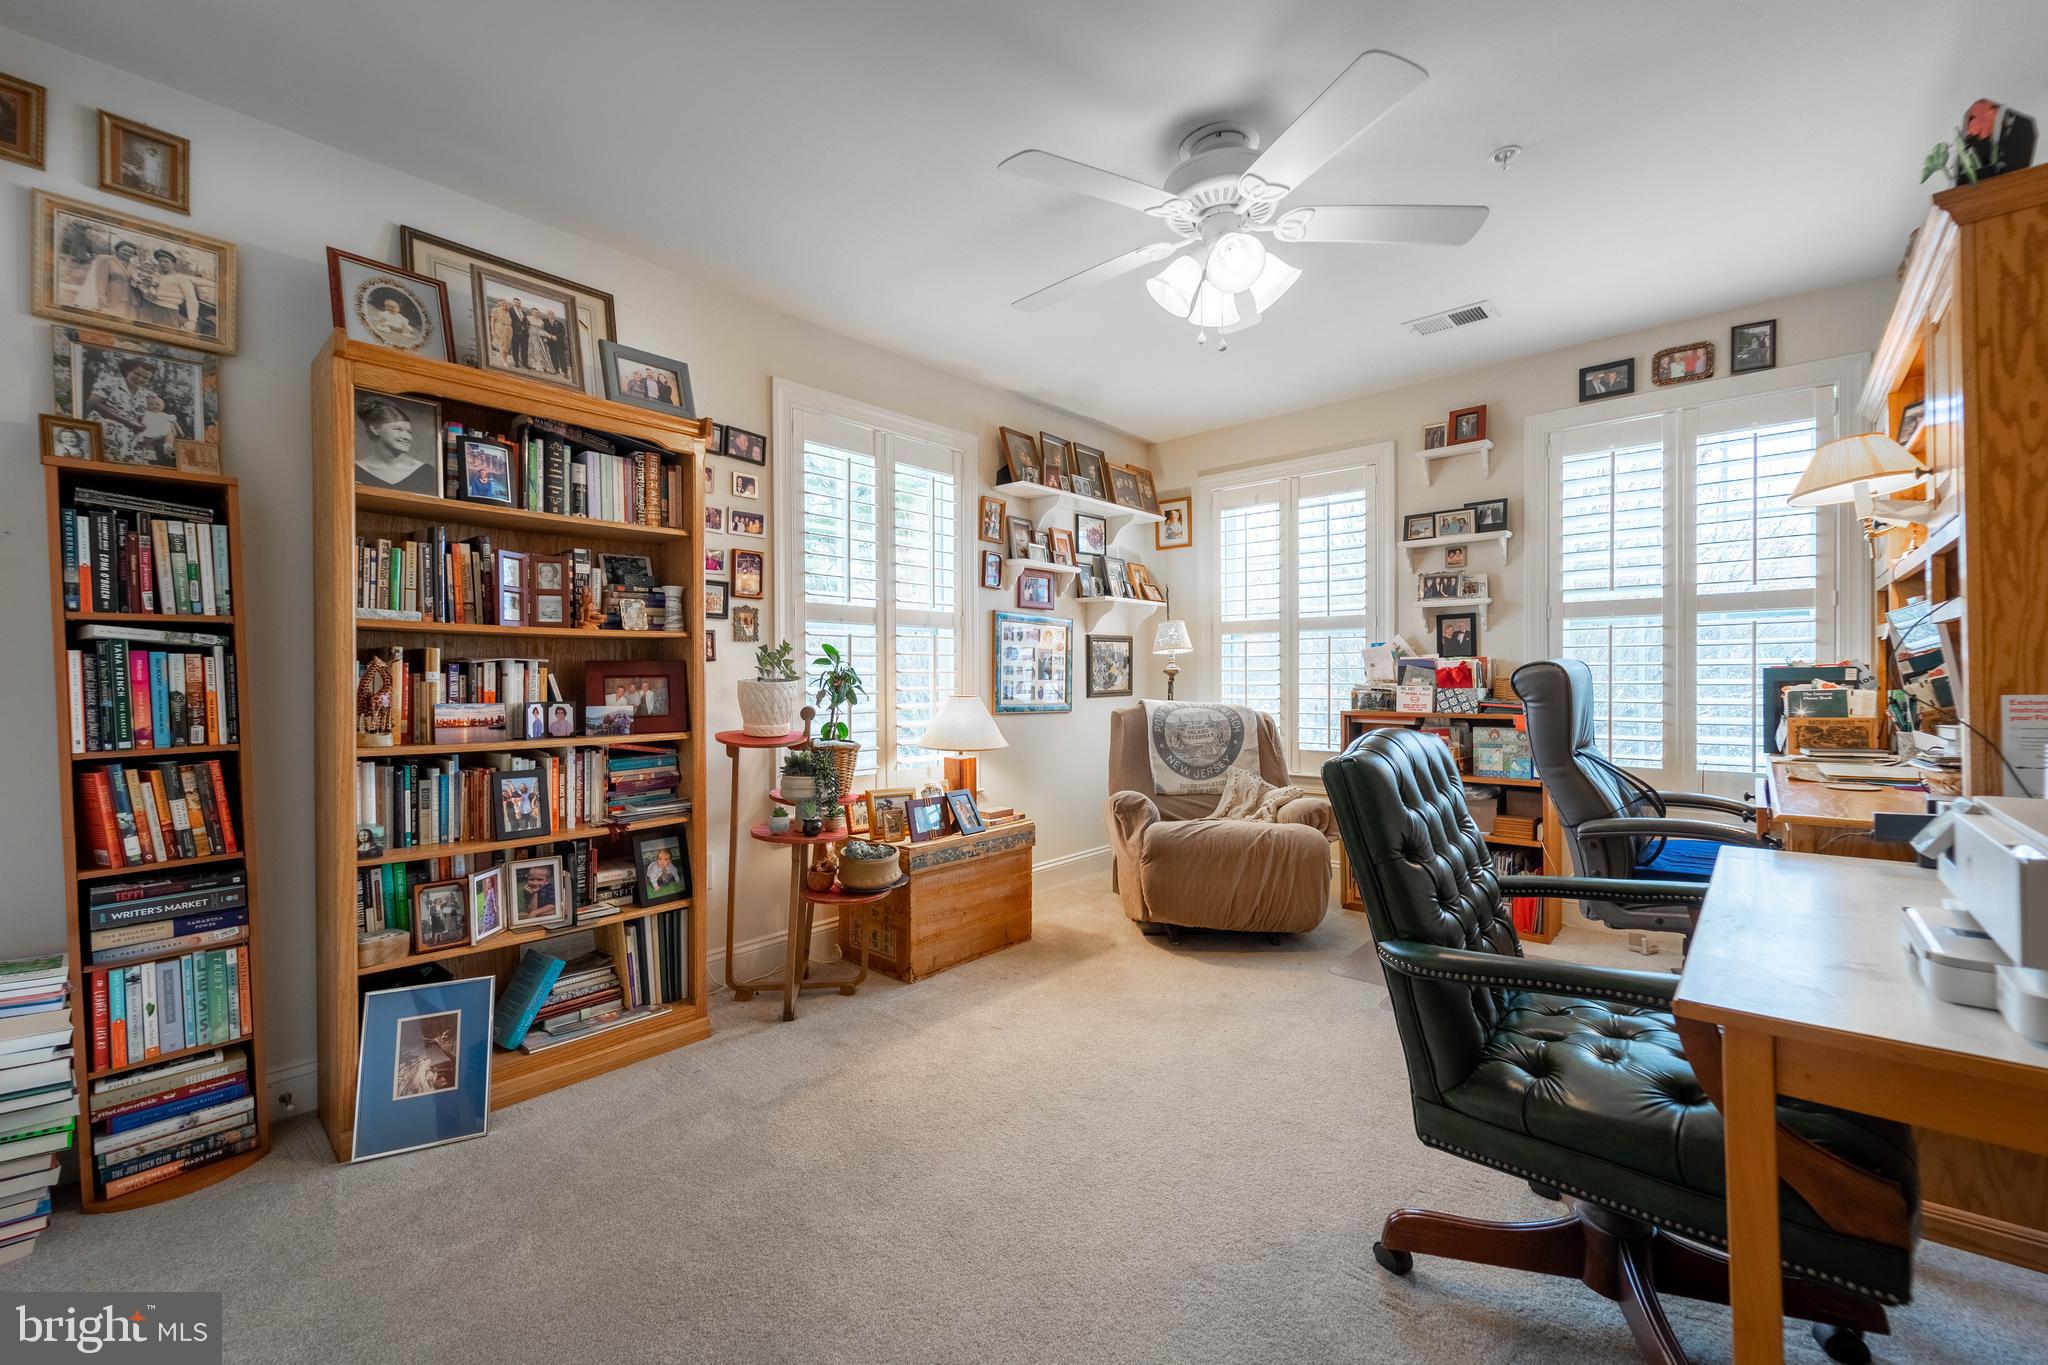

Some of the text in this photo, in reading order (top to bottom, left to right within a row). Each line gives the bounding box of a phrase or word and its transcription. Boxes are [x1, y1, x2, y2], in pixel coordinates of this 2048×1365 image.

[651, 456, 659, 505] HERE I AM
[65, 510, 75, 572] THE GREEN ROAD
[99, 554, 109, 571] EDNA
[100, 572, 111, 600] O'BRIEN
[113, 644, 123, 664] TANA
[116, 667, 126, 697] FRENCH
[174, 695, 183, 722] Shannon
[120, 713, 128, 739] SEARCHER
[1165, 754, 1232, 778] NEW JERSEY
[577, 855, 587, 888] ENGLISH
[115, 888, 145, 903] TEFFI
[111, 897, 209, 921] WRITER'S MARKET
[187, 916, 224, 926] SAMANTHA
[213, 956, 223, 991] TRUST
[240, 952, 249, 991] WINTERING
[95, 990, 107, 1017] LEAVERS
[95, 1026, 107, 1041] LISA
[184, 1065, 230, 1085] YELLOWFACE
[111, 1143, 206, 1180] THE JOY LUCK CLUB AMY TAN
[205, 1149, 224, 1159] SING
